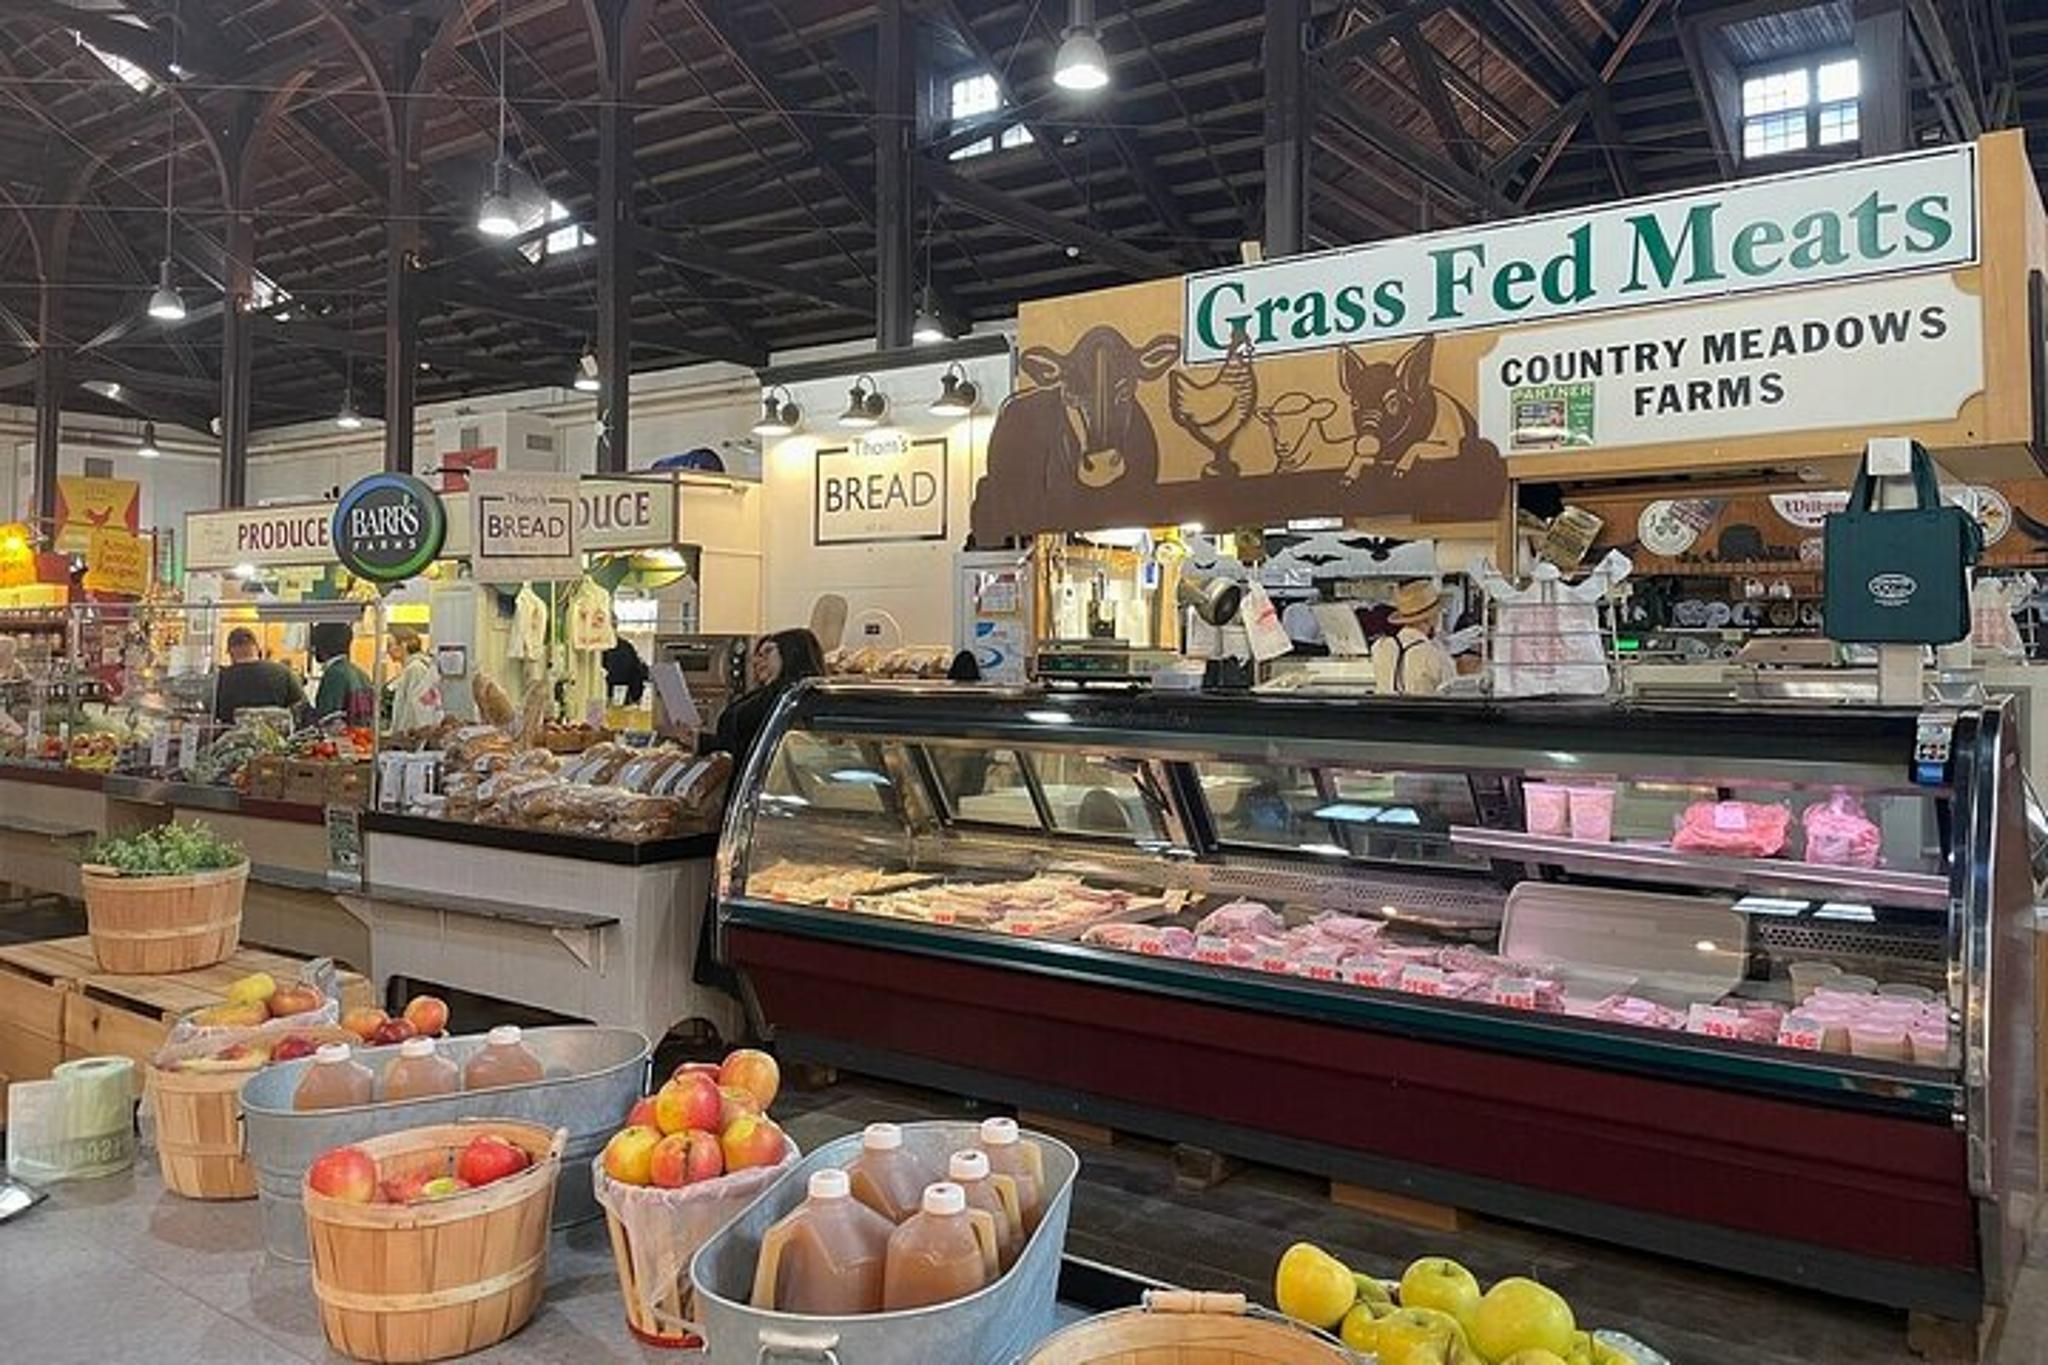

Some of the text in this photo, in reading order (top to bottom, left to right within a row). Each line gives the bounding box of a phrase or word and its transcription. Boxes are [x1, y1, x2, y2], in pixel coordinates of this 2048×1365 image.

[1196, 189, 1953, 351] Grass Fed Meats
[1499, 304, 1949, 387] COUNTRY MEADOWS
[1512, 385, 1593, 402] PARTNER
[1633, 372, 1786, 417] FARMS
[852, 435, 909, 457] Thom's
[825, 471, 938, 513] BREAD
[237, 517, 329, 551] PRODUCE
[352, 494, 419, 538] BARR'S
[487, 514, 565, 539] BREAD
[353, 539, 417, 552] FARMS
